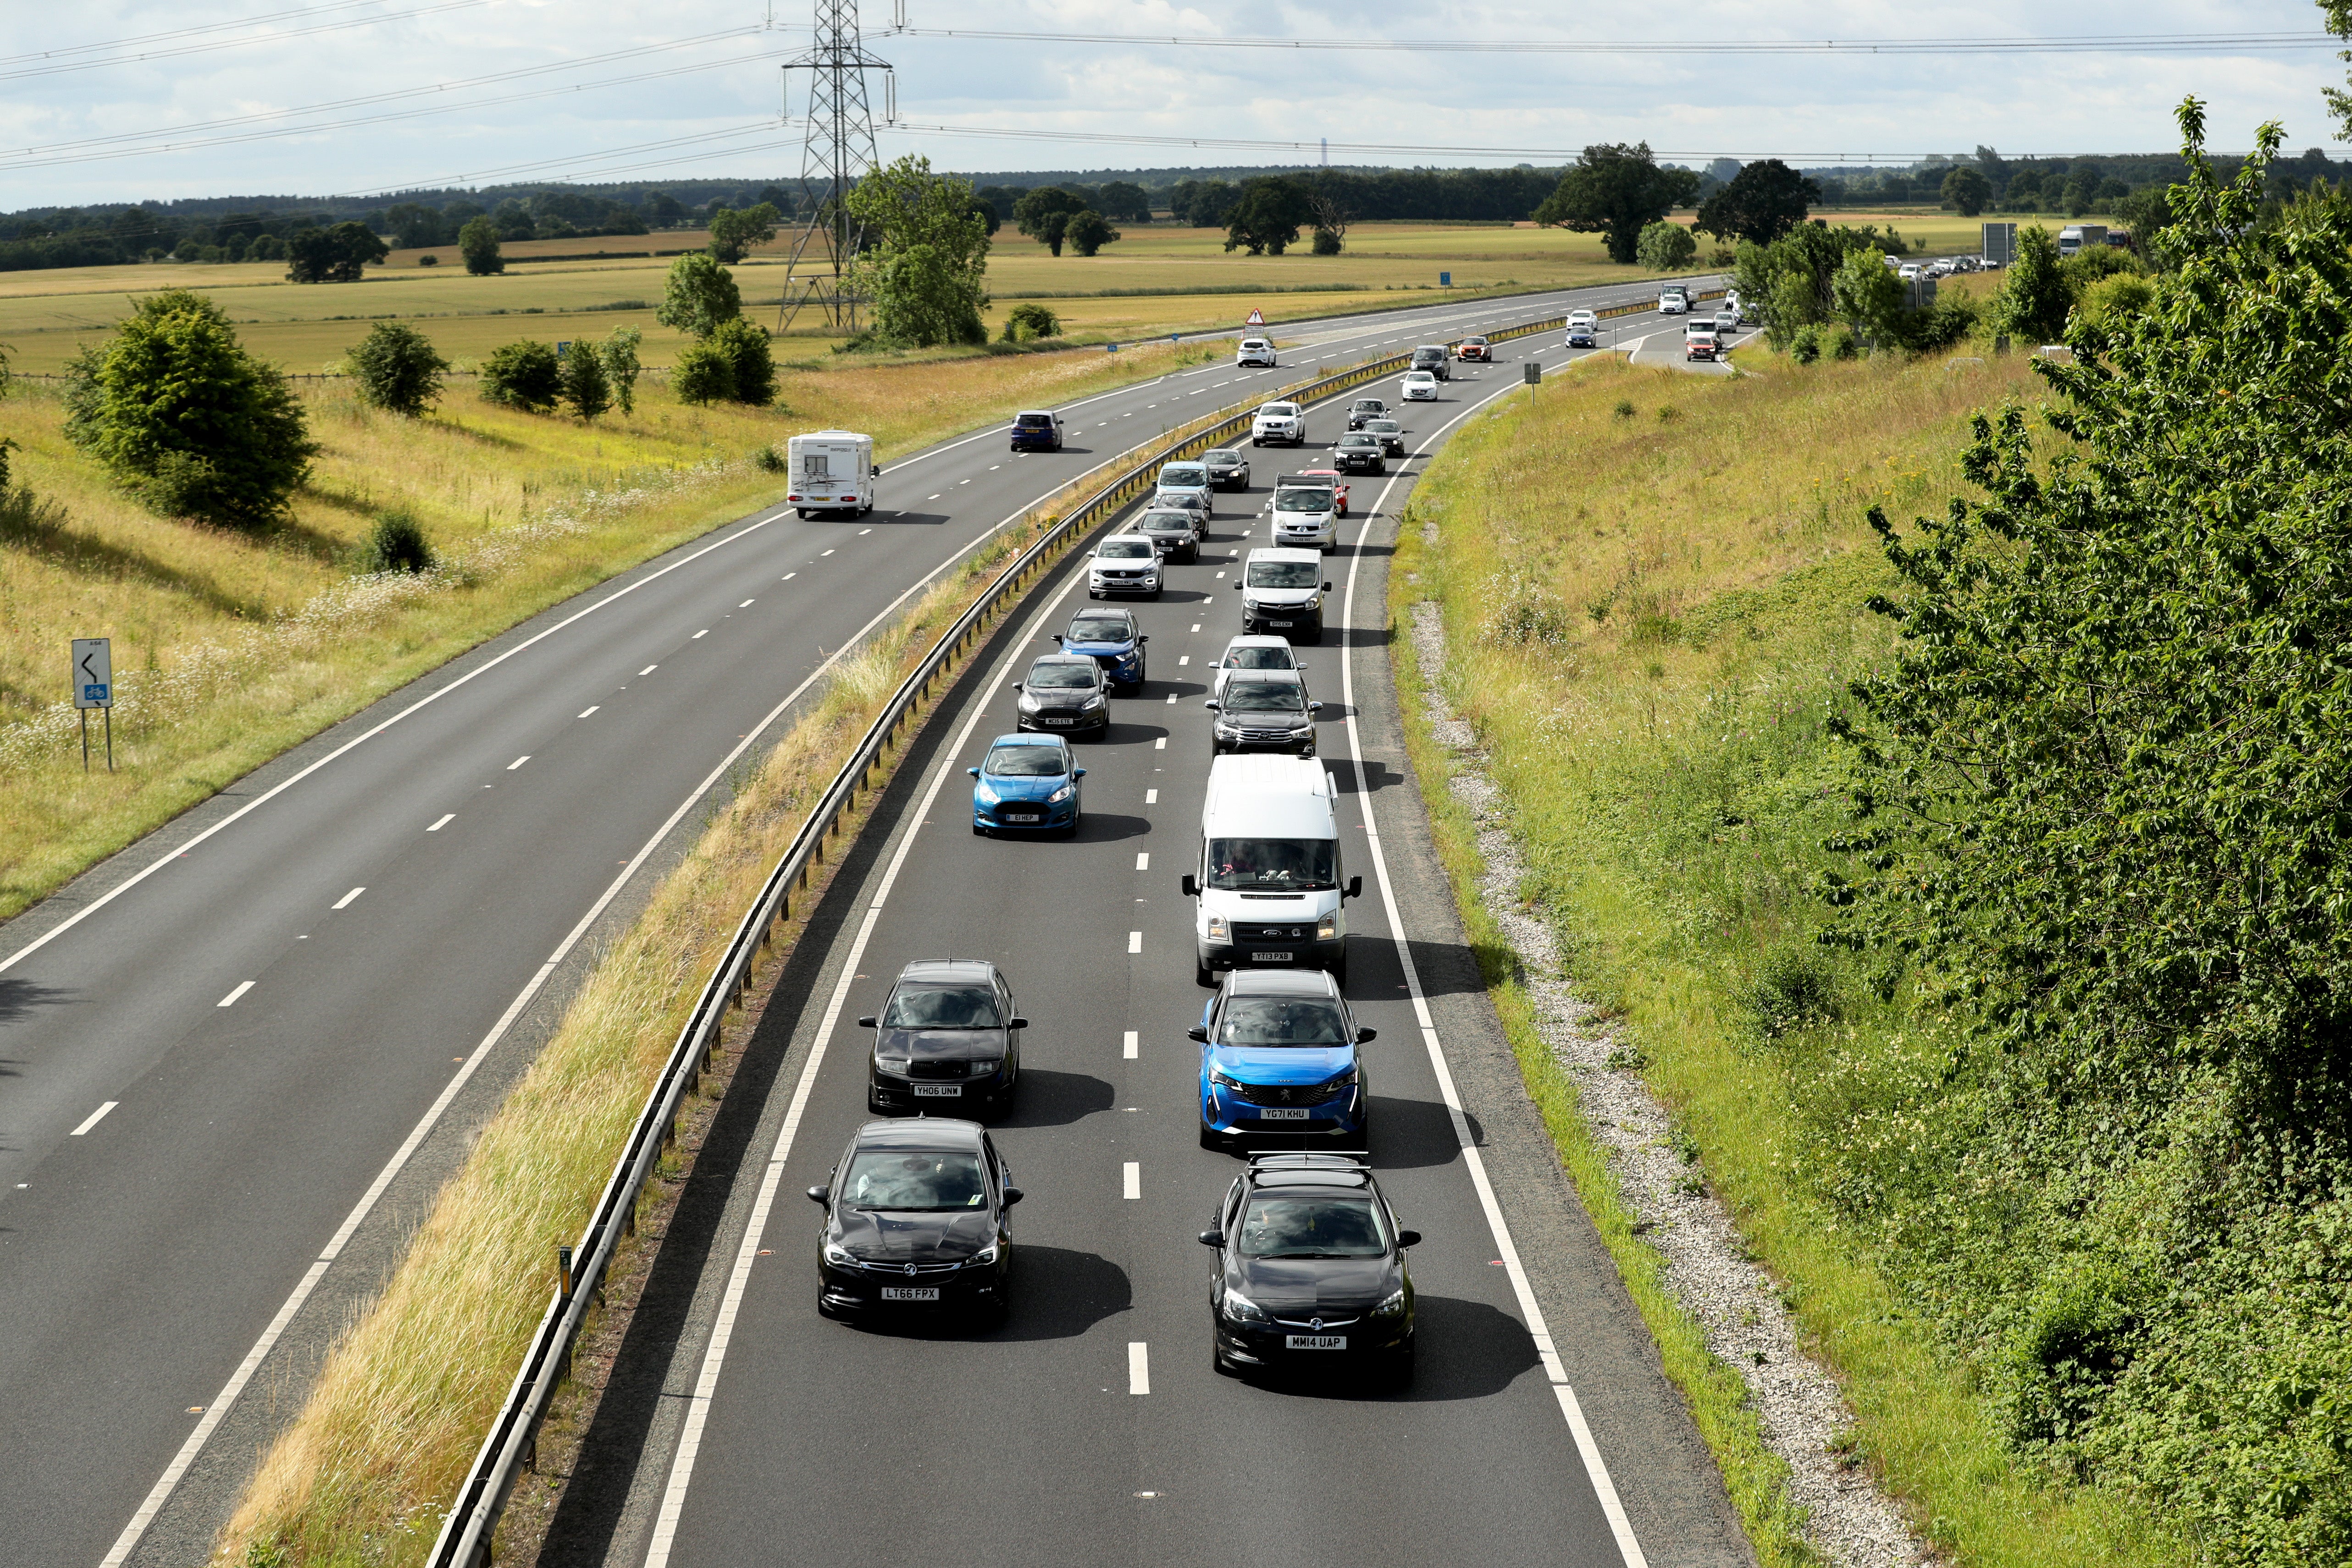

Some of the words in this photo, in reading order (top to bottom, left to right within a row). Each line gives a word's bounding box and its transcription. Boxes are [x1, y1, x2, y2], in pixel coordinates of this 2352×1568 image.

[1287, 1110, 1304, 1118] KHU
[886, 1288, 913, 1298] LT66
[915, 1289, 935, 1298] FPX
[1293, 1337, 1316, 1347] MM14
[1319, 1337, 1340, 1347] UAP
